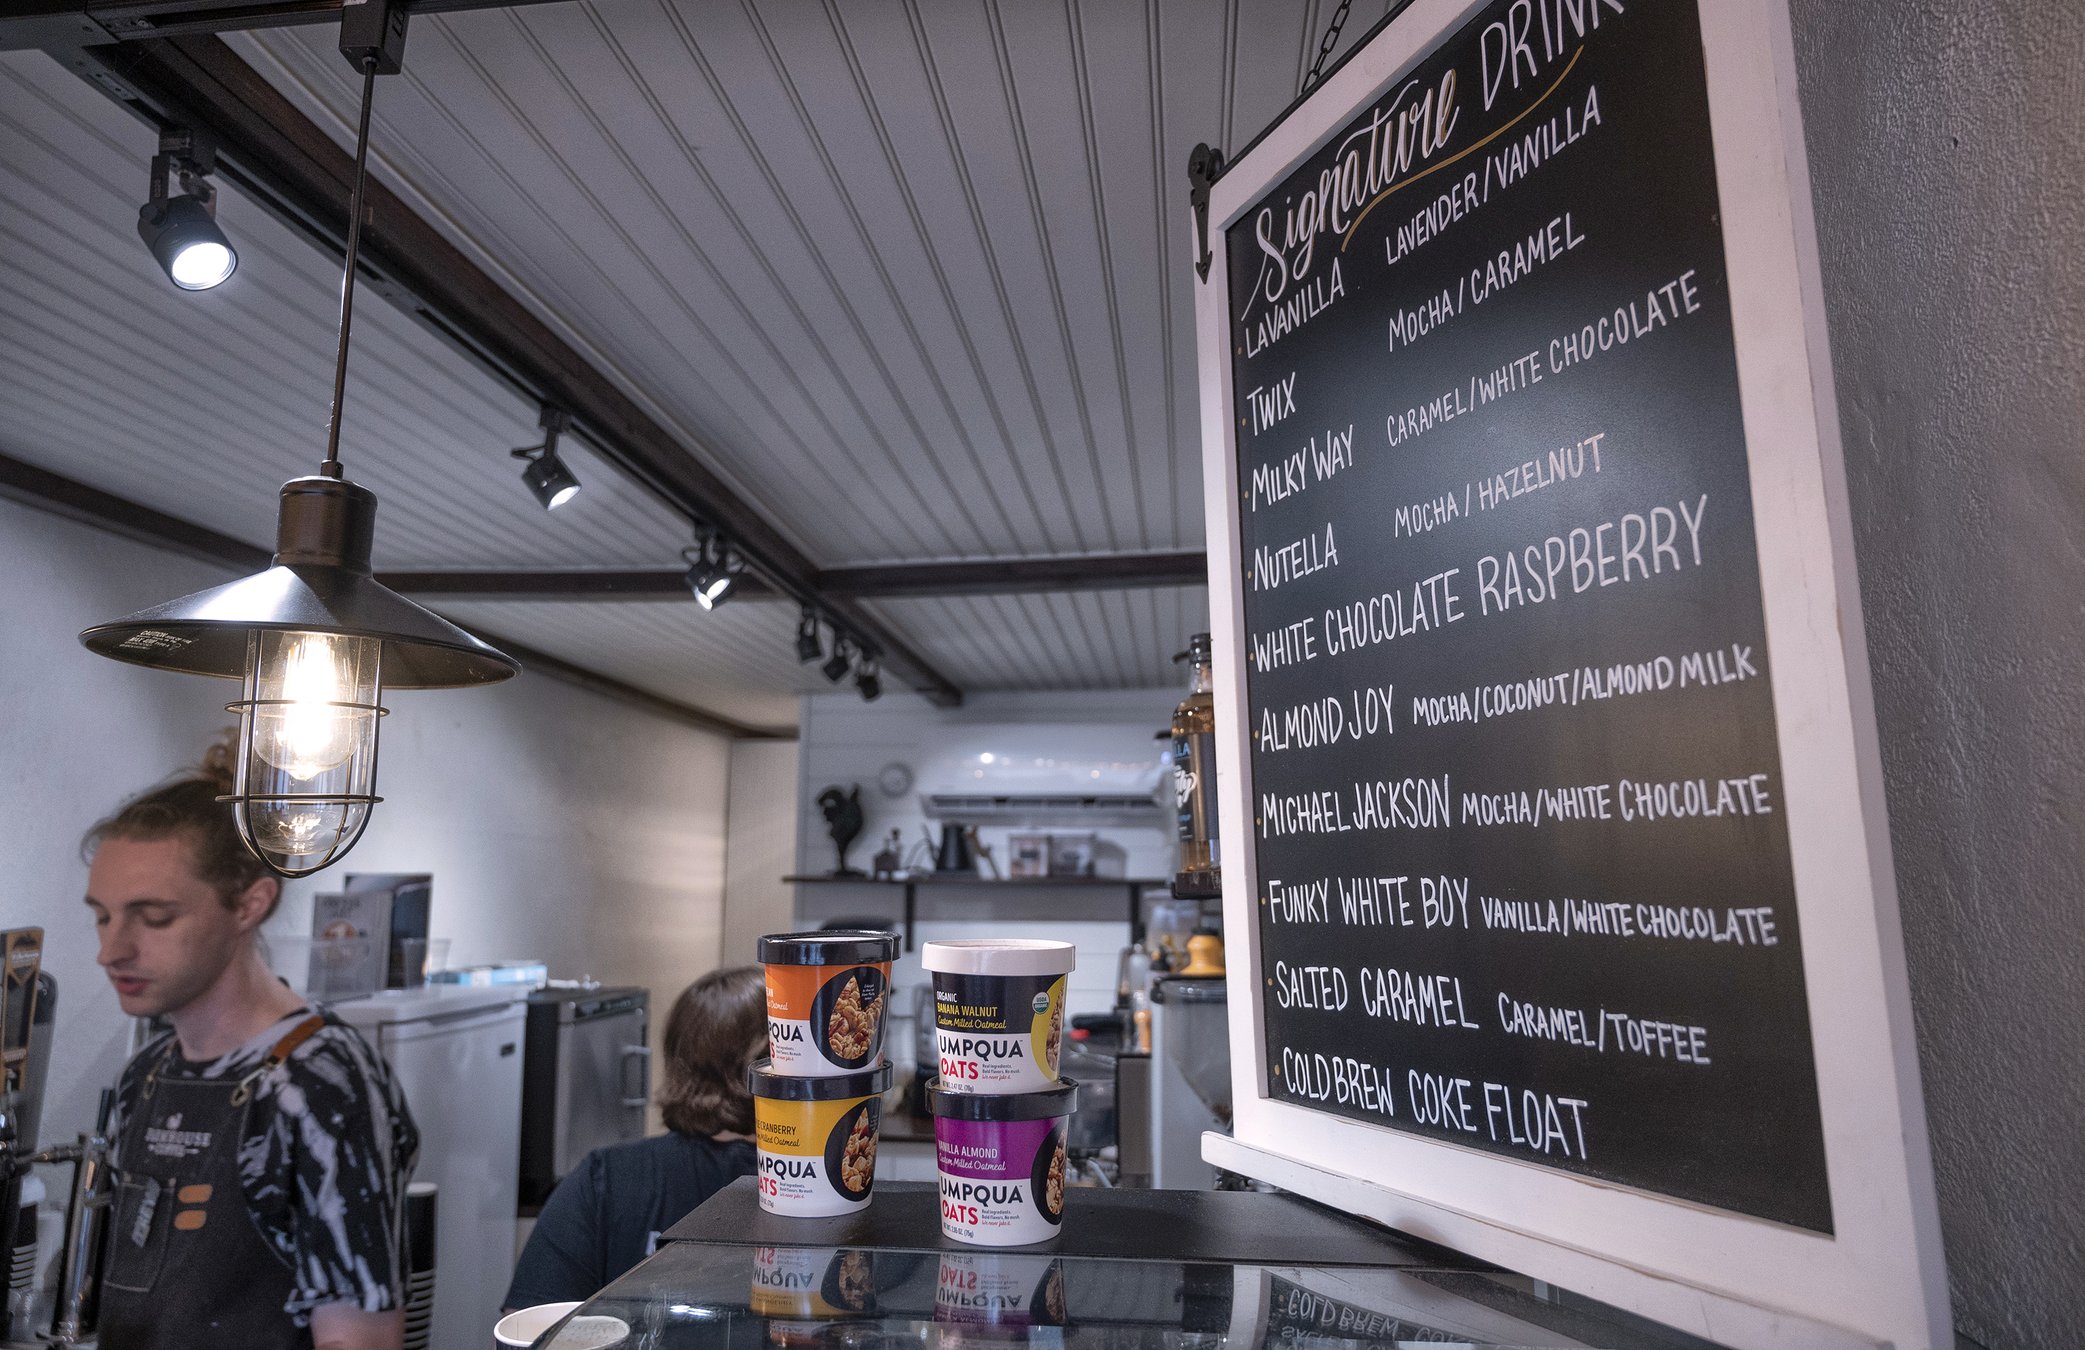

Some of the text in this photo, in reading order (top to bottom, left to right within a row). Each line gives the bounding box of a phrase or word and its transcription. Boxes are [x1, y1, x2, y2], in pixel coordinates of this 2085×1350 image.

[1241, 69, 1459, 321] Signature
[1245, 257, 1345, 359] LAVANILLA
[1246, 372, 1296, 436] TWIX
[1252, 455, 1309, 511] MILKY
[1311, 424, 1354, 483] WAY
[1550, 269, 1700, 374] CHOCOLATE
[1253, 522, 1338, 591] NUTELLA
[1253, 494, 1708, 673] WHITE CHOCOLATE RASPBERRY
[1260, 697, 1343, 753] ALMOND
[1348, 685, 1394, 741] JOY
[1679, 644, 1757, 690] MILK
[1262, 791, 1351, 838] MICHAEL
[1353, 774, 1451, 830] JACKSON
[1618, 774, 1771, 822] CHOCOLATE
[1268, 878, 1329, 925] FUNKY
[1337, 876, 1414, 927] WHITE
[1420, 875, 1468, 929] BOY
[1636, 905, 1778, 947] CHOCOLATE
[937, 991, 957, 1002] ORGANIC
[1275, 960, 1348, 1012] SALTED
[1361, 967, 1479, 1030] CARAMEL
[937, 1002, 998, 1018] BANANA WALNUT
[953, 1017, 974, 1028] Milled
[974, 1018, 1006, 1029] Oatmeal
[939, 1035, 1024, 1061] UMPQUA
[941, 1058, 979, 1080] OATS
[760, 1121, 797, 1135] CRANBERRY
[1408, 1069, 1477, 1134] COKE
[1483, 1082, 1588, 1160] FLOAT
[774, 1136, 800, 1147] Oatmeal
[938, 1139, 998, 1158] VANILLA ALMOND
[758, 1155, 817, 1180] MPQUA
[953, 1157, 973, 1168] Milled
[974, 1160, 1006, 1171] Oatmeal
[758, 1177, 777, 1196] ATS
[940, 1176, 1023, 1207] UMPQUA
[942, 1199, 979, 1225] OATS
